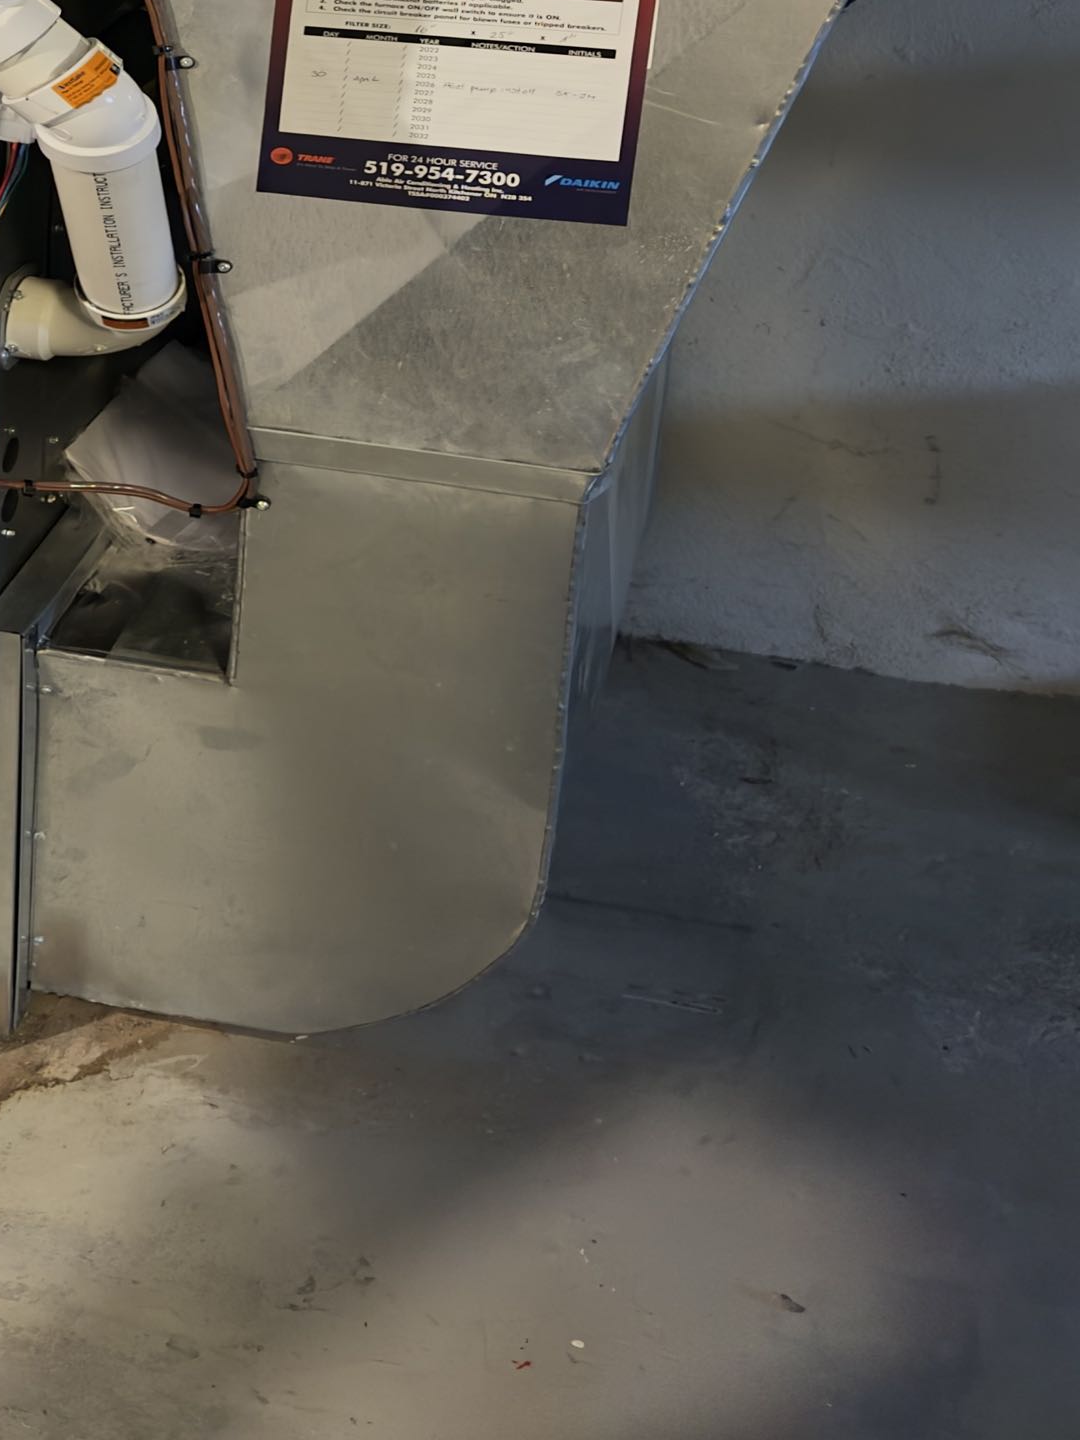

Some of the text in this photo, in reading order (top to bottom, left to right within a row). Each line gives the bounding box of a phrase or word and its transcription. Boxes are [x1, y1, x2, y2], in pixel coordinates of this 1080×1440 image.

[366, 33, 397, 41] MONTH
[471, 42, 535, 51] NOTES/ACTION
[568, 49, 602, 57] INITIALS
[296, 153, 335, 163] TRANE
[387, 153, 498, 170] FOR 24 HOUR SERVICE
[363, 160, 521, 187] 519-954-7300
[559, 176, 619, 191] DAIKIN
[103, 214, 126, 268] INSTALLATION
